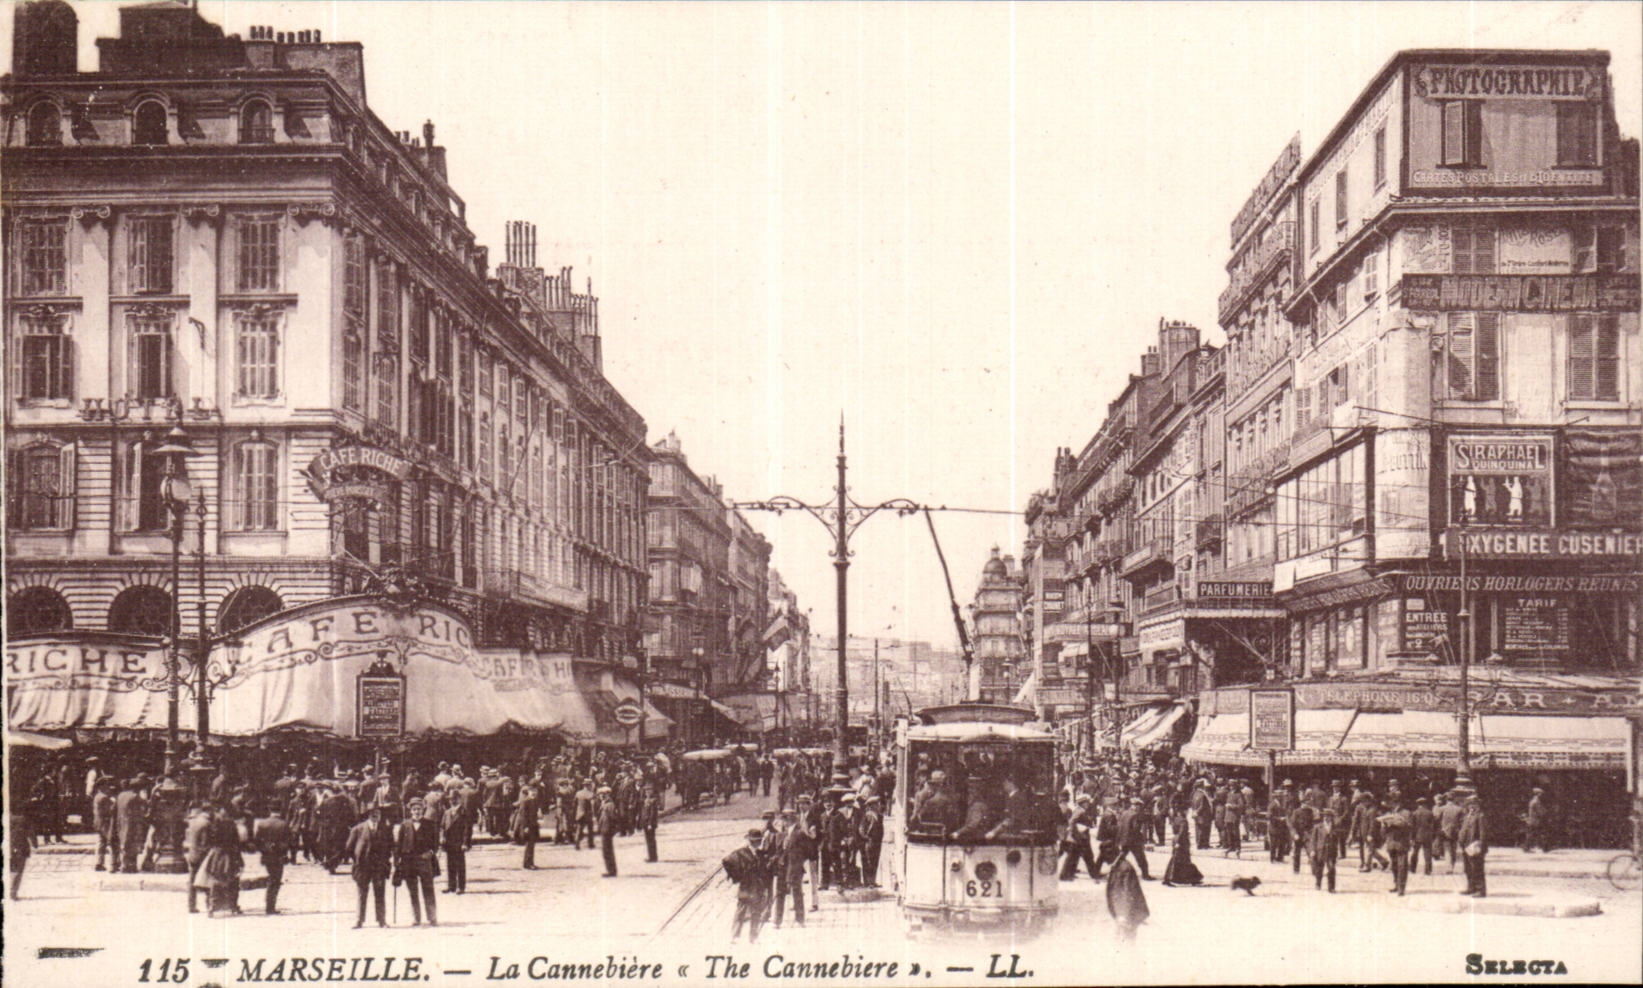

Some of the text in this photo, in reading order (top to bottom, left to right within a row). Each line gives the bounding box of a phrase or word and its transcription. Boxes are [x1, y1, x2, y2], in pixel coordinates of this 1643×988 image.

[1430, 67, 1585, 95] PHOTOGRAPHIE
[1413, 171, 1455, 183] CARTES
[360, 446, 401, 477] RICHE
[1475, 444, 1545, 469] RAPHAEL
[1471, 460, 1533, 471] QUINQUINA
[1200, 583, 1271, 597] PARFUMERIE
[1405, 575, 1481, 591] OUVRIERS
[1483, 575, 1574, 592] HORLOGERS
[1518, 598, 1557, 608] TARIF
[966, 879, 1004, 898] 621
